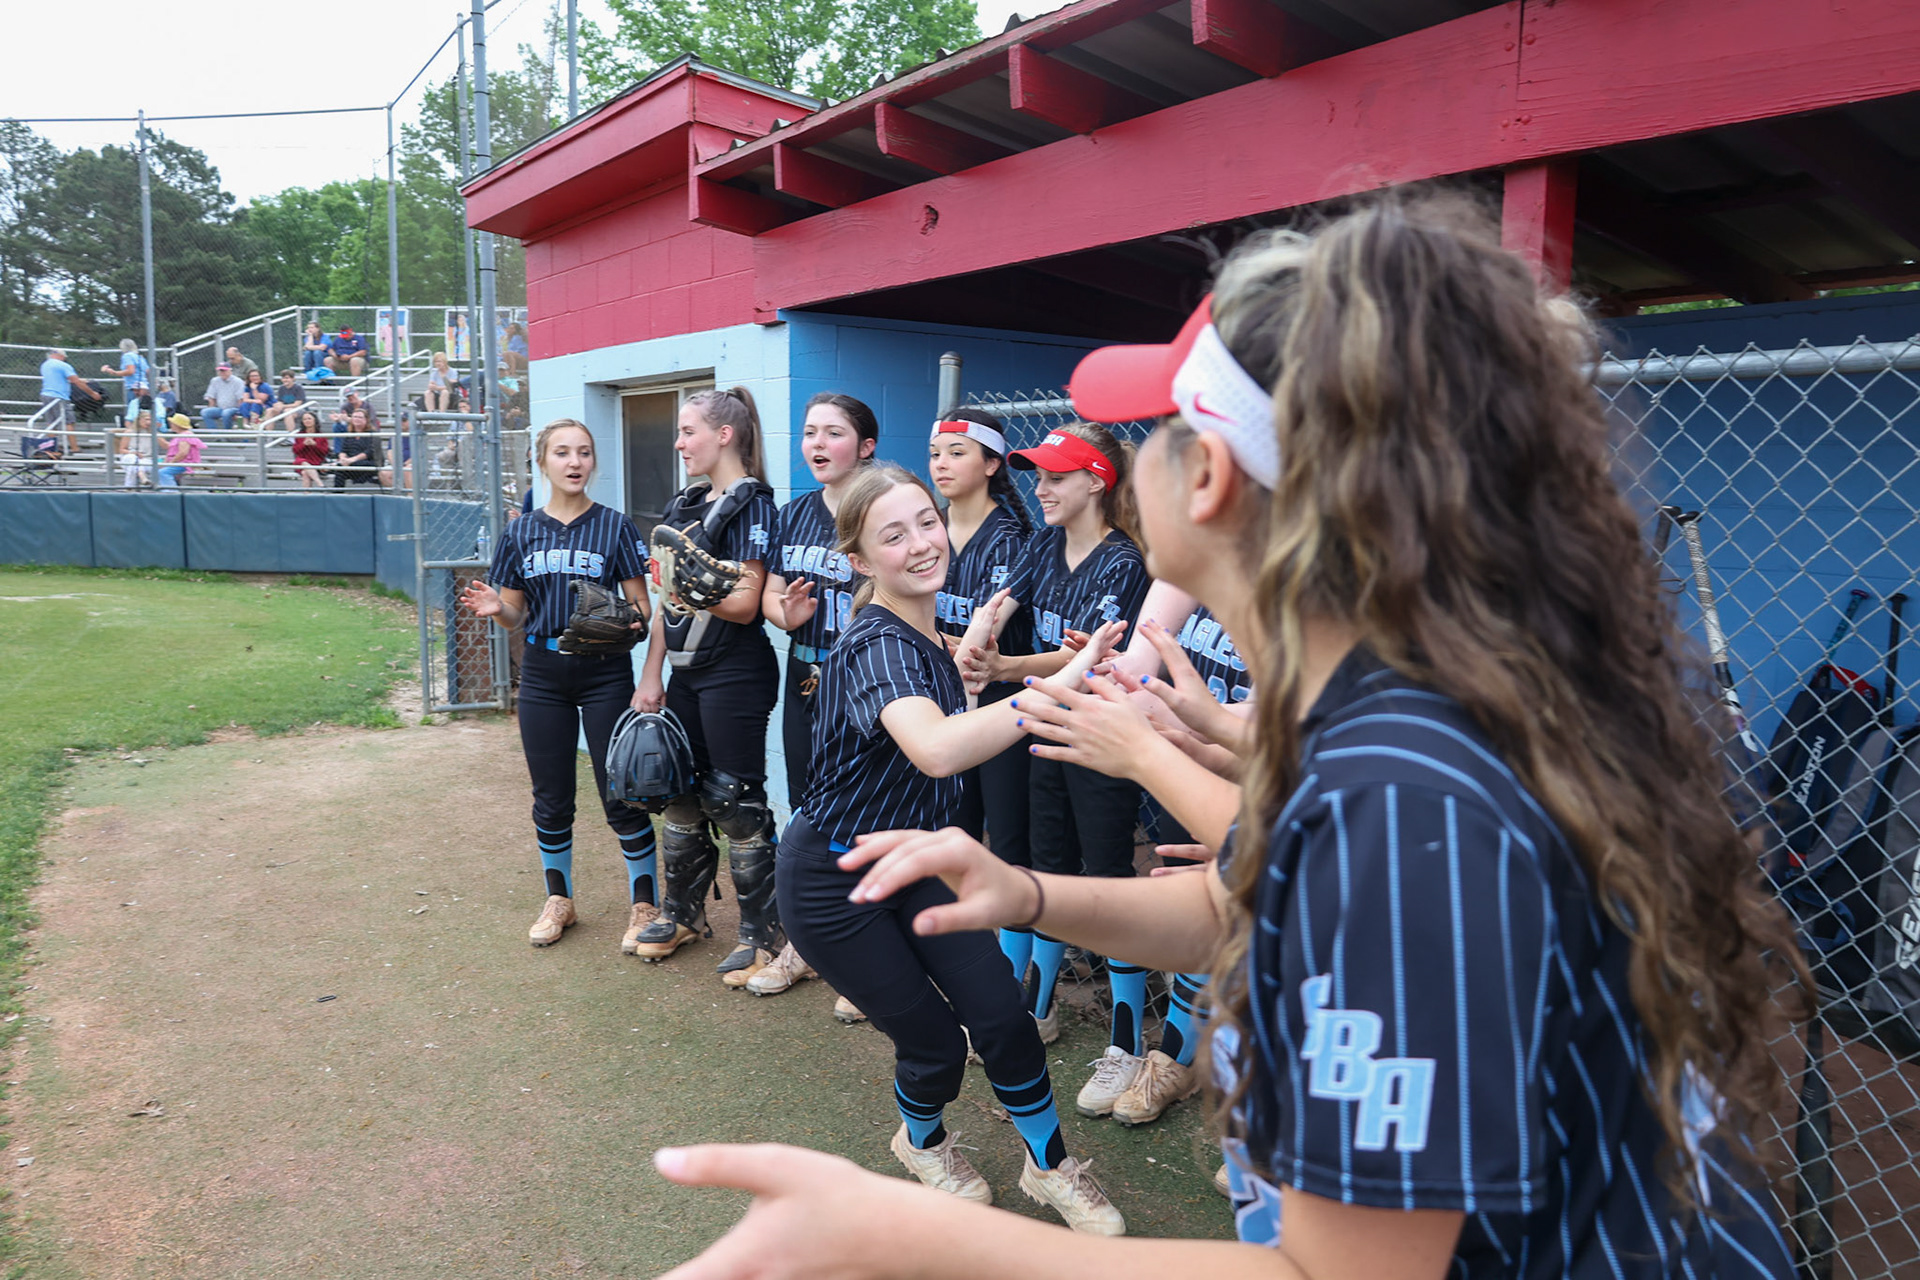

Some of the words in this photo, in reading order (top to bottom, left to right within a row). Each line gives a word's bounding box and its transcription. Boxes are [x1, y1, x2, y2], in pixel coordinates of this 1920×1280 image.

[522, 549, 604, 579] EAGLES
[781, 545, 853, 582] EAGLES
[824, 589, 854, 633] 18
[1096, 594, 1121, 622] SB
[1796, 735, 1827, 805] EASTON
